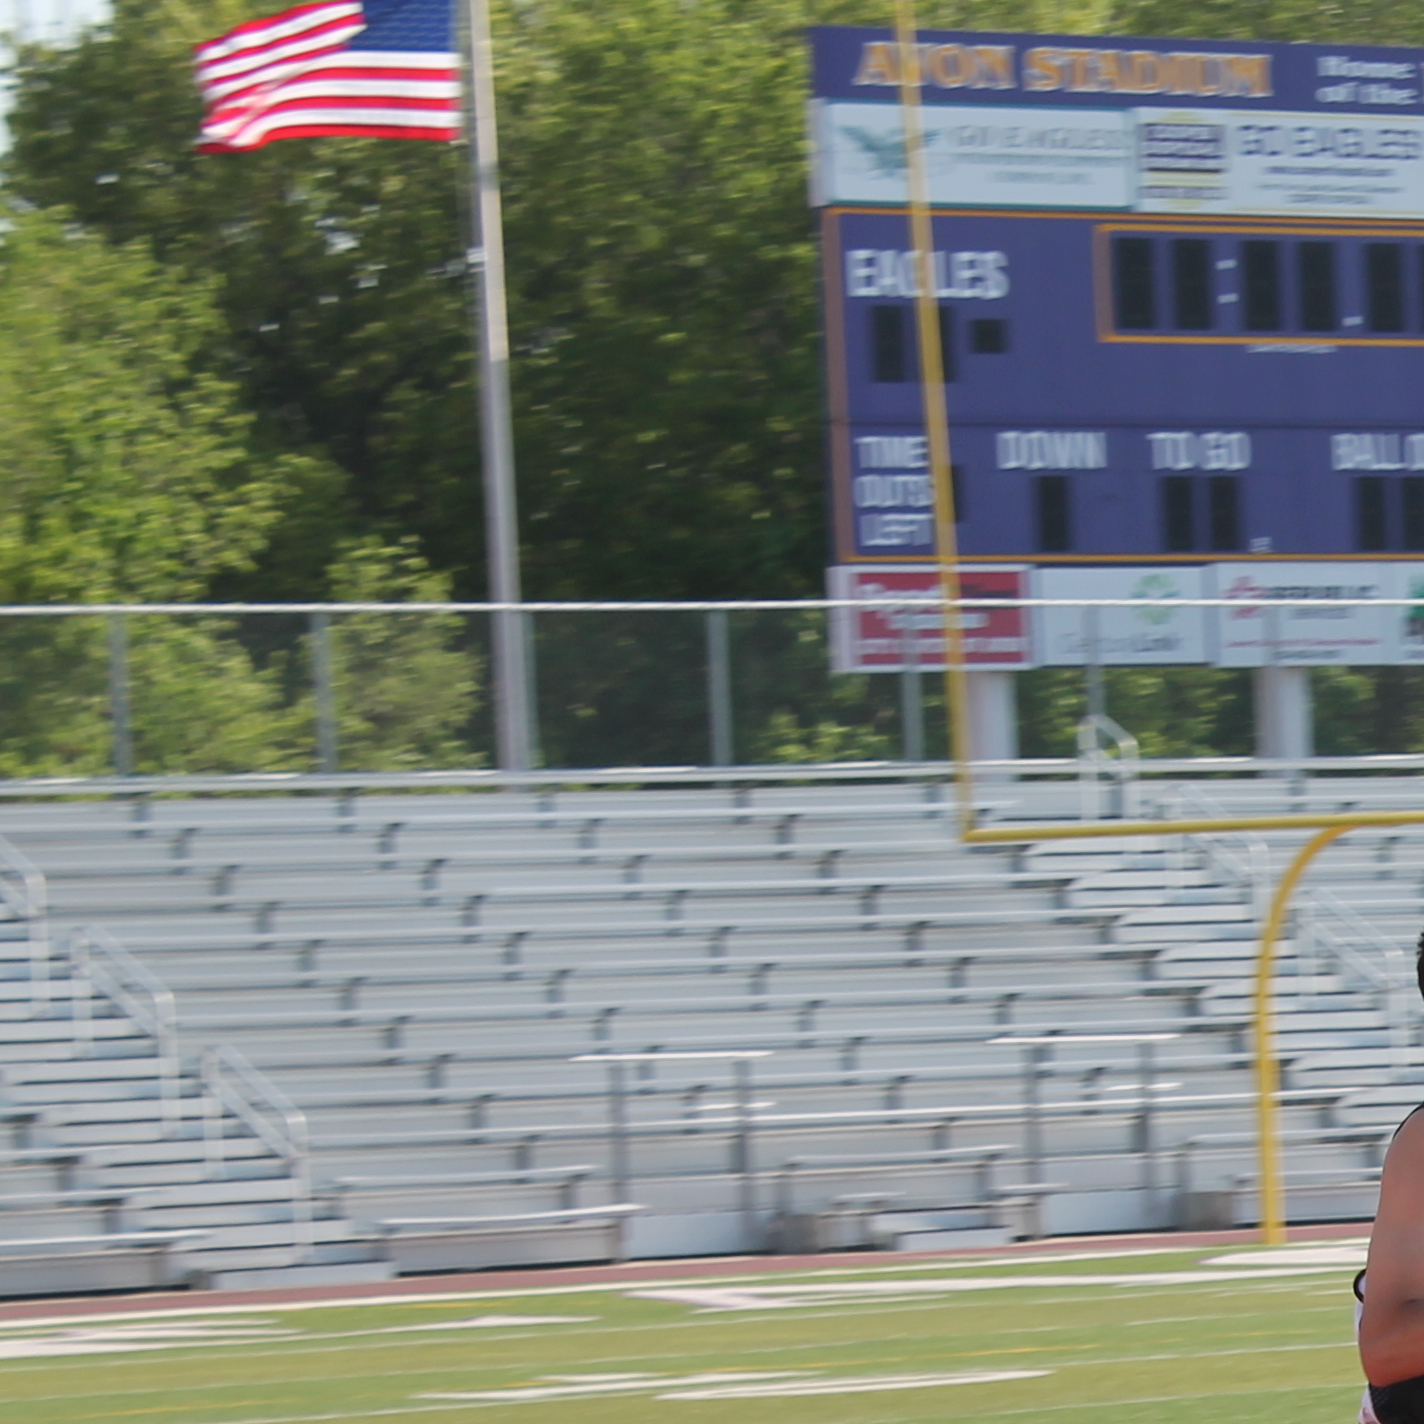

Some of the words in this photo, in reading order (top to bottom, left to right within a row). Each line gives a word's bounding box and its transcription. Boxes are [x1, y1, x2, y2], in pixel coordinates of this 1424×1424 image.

[1023, 46, 1275, 98] STADIUM
[1316, 55, 1418, 79] Home
[1315, 81, 1357, 103] of
[1362, 82, 1419, 106] the
[855, 435, 930, 469] TIME
[996, 430, 1108, 470] DOWN
[859, 512, 934, 546] LEFT
